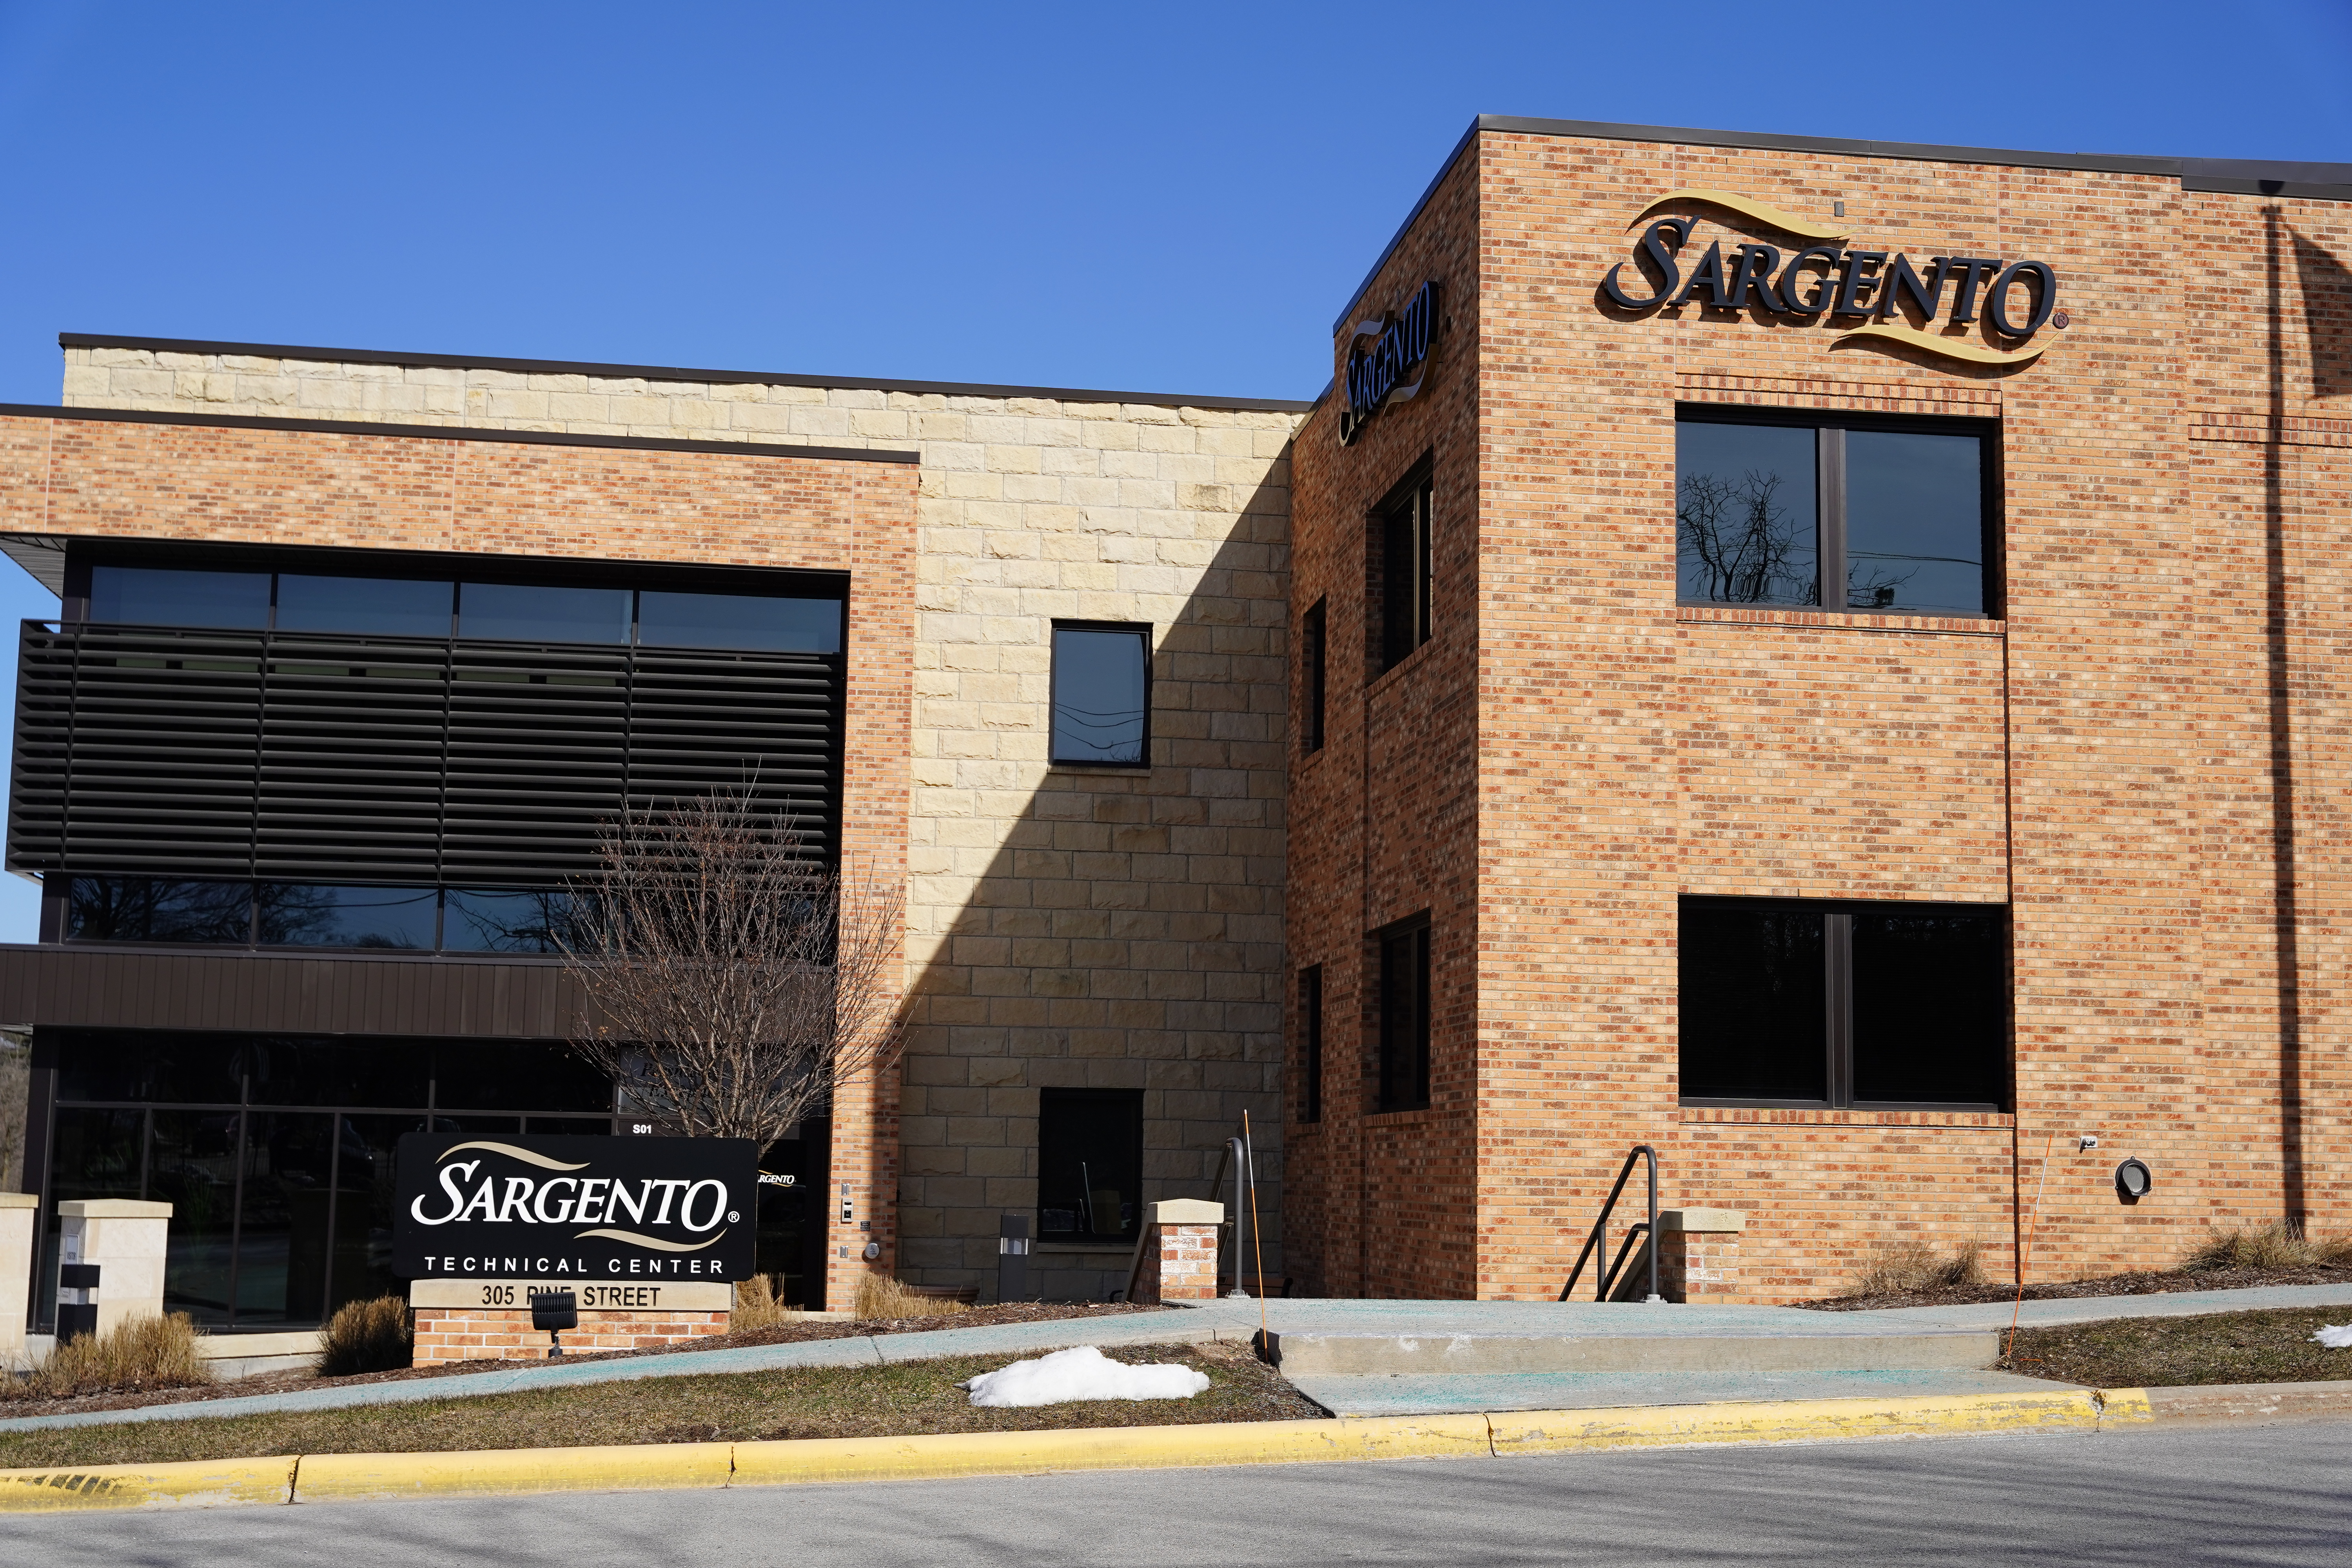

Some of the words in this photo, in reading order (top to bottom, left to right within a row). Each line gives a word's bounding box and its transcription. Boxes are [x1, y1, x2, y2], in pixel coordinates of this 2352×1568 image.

[632, 1124, 652, 1134] S01
[758, 1175, 795, 1184] RGENTO
[425, 1257, 587, 1272] TECHNICAL
[608, 1259, 722, 1274] CENTER
[482, 1285, 514, 1305] 305
[583, 1286, 661, 1306] STREET
